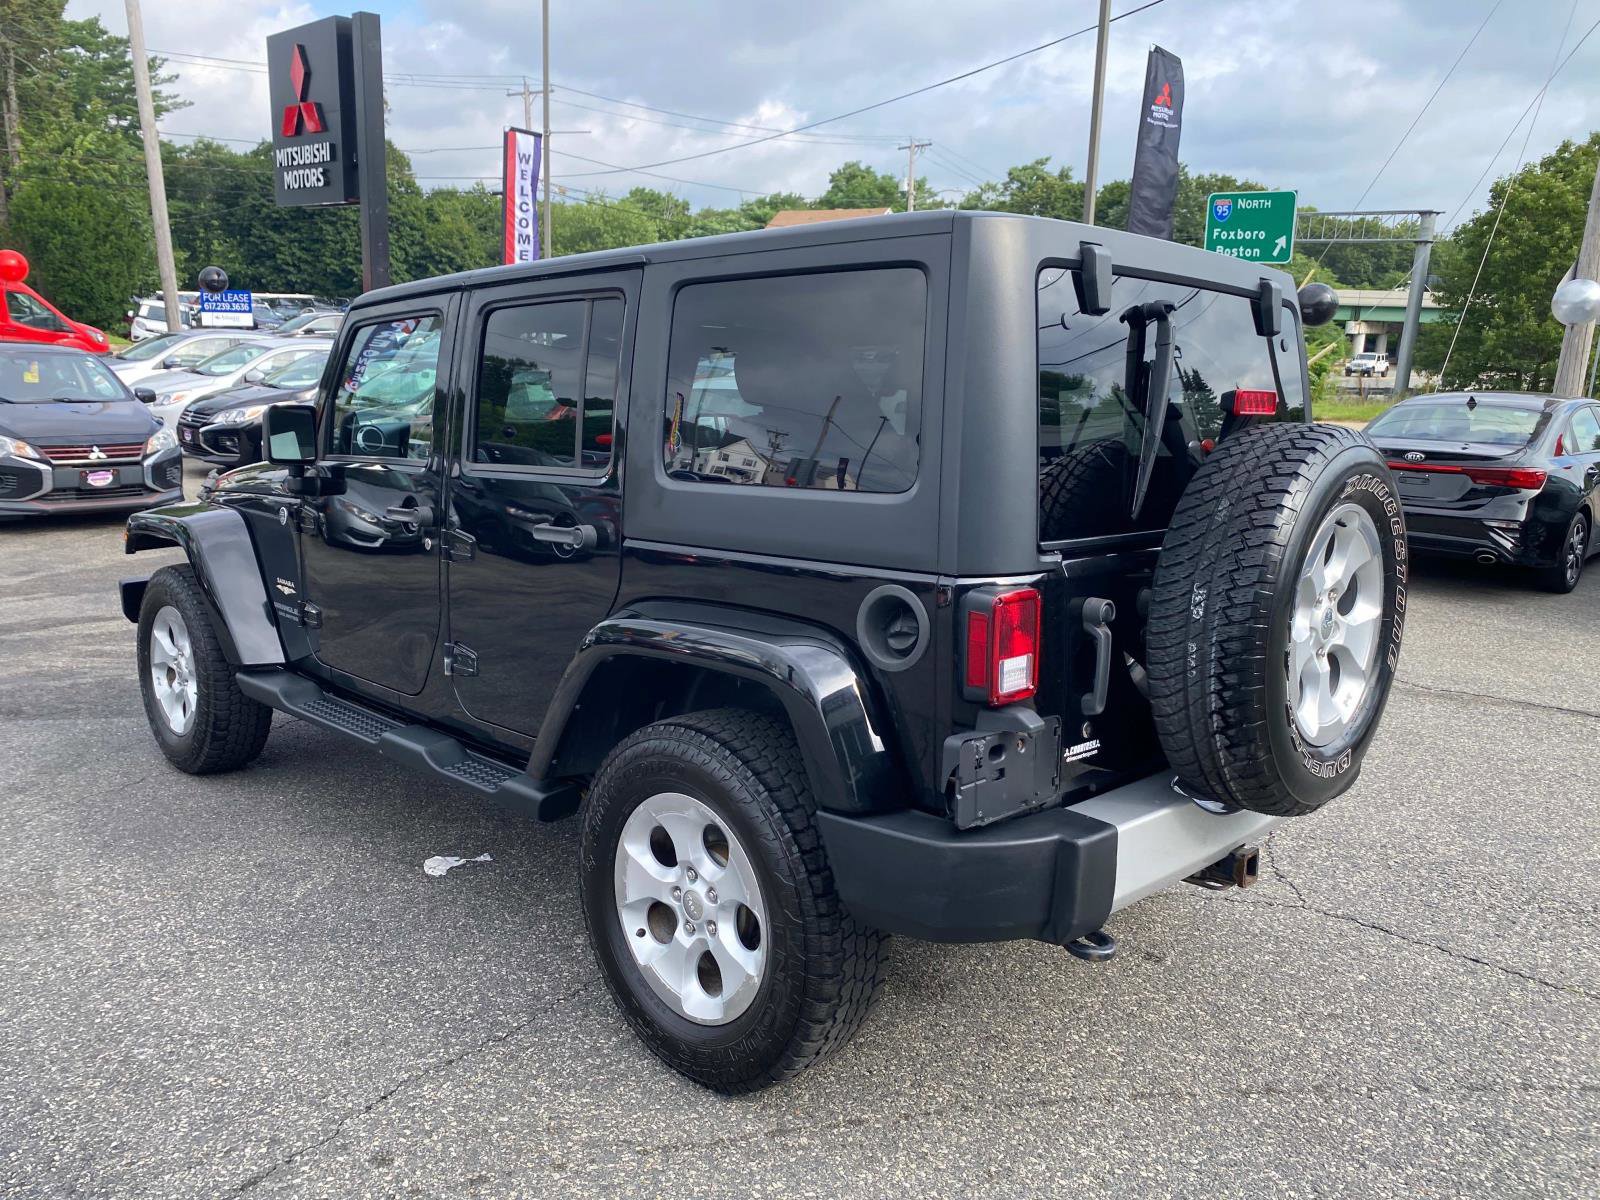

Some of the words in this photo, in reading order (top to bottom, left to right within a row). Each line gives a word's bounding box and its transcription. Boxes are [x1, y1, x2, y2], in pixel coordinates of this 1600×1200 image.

[276, 142, 331, 168] MITSUBISHI
[283, 167, 325, 190] MOTORS
[518, 153, 531, 261] WELCOME
[1237, 199, 1272, 209] NORTH
[1216, 205, 1229, 216] 95
[1213, 229, 1266, 239] Foxboro
[1216, 246, 1260, 257] Boston
[203, 293, 220, 301] FOR
[223, 293, 249, 302] LEASE
[204, 302, 250, 311] 617.239.3636
[1341, 474, 1407, 672] BRIDGESTONE
